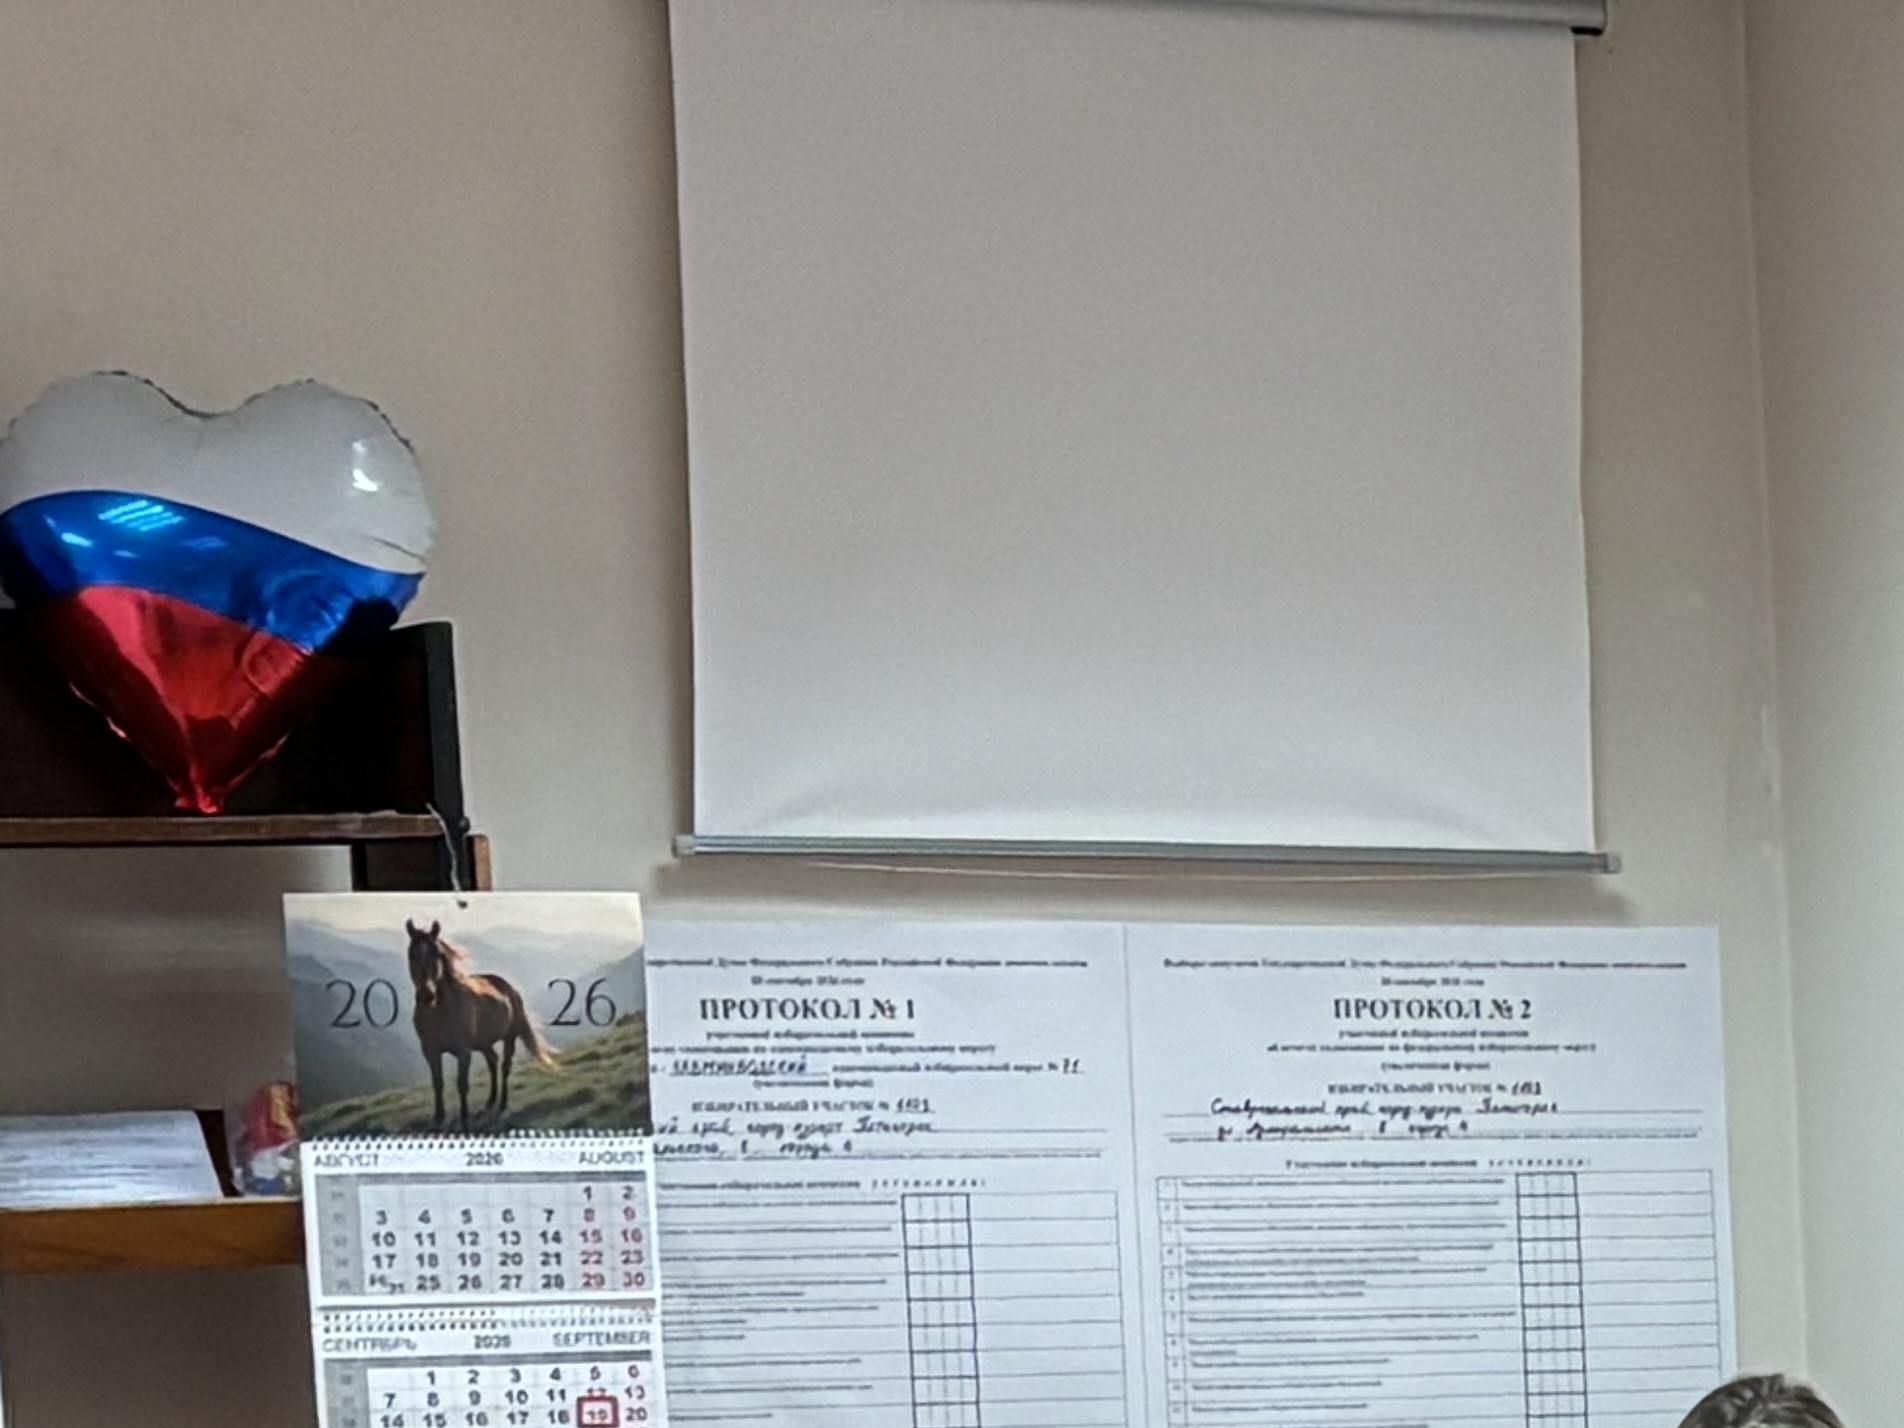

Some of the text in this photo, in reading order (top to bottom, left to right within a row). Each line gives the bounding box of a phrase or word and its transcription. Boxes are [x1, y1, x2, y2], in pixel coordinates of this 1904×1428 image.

[326, 978, 617, 1029] 20 26
[700, 997, 915, 1020] ПРОТОКОЛ № 1
[1333, 998, 1532, 1020] ПРОТОКОЛ № 2
